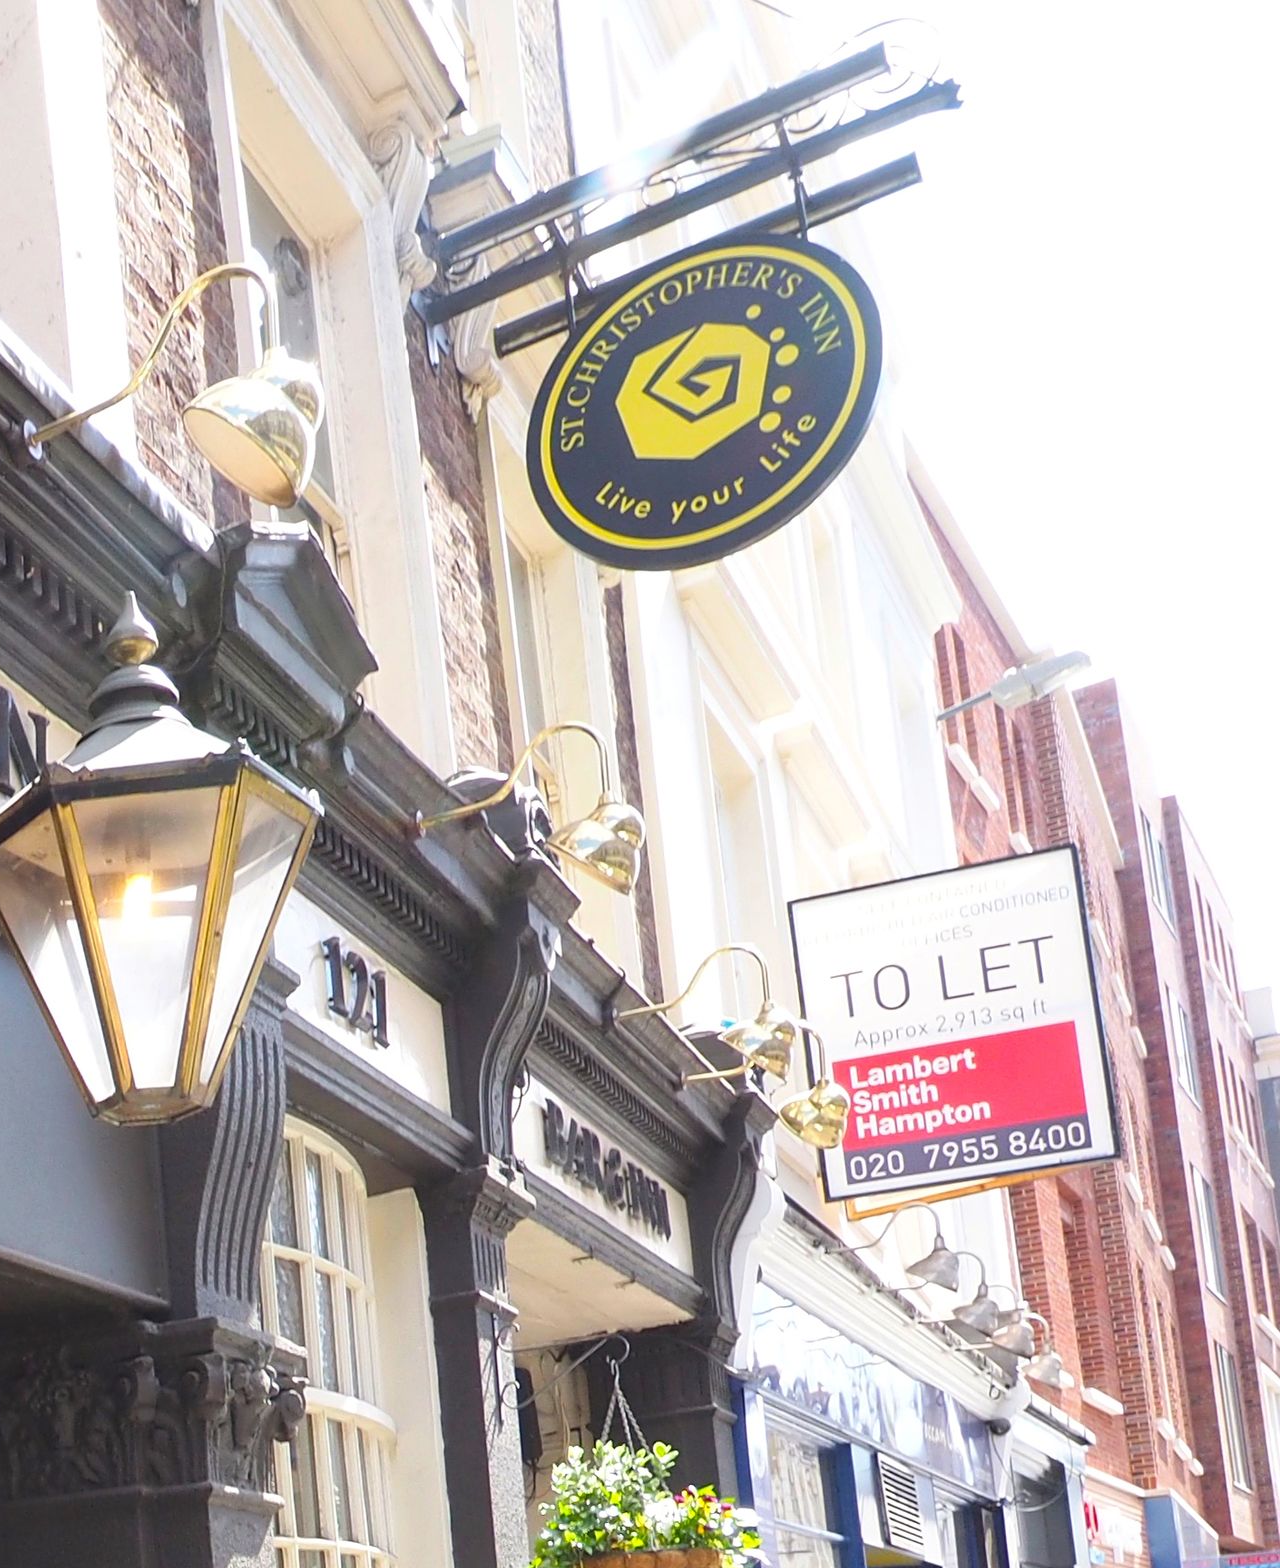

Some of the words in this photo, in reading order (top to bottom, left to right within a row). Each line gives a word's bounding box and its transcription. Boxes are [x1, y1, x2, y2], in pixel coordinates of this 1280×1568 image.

[800, 293, 842, 356] INN
[595, 480, 652, 520] Live
[671, 477, 745, 524] your
[759, 413, 817, 473] Life
[959, 886, 1070, 919] CONDITIONED
[830, 964, 910, 1018] TO
[938, 935, 1054, 1001] LET
[854, 1022, 928, 1048] Approx
[936, 1008, 993, 1033] 2,913
[1000, 1005, 1025, 1023] sq
[1033, 999, 1048, 1016] ft
[849, 1048, 976, 1090] Lambert
[853, 1079, 939, 1115] Smith
[856, 1100, 991, 1140] Hampton
[850, 1151, 905, 1181] 020
[924, 1135, 1000, 1169] 7955
[1009, 1121, 1086, 1156] 8400
